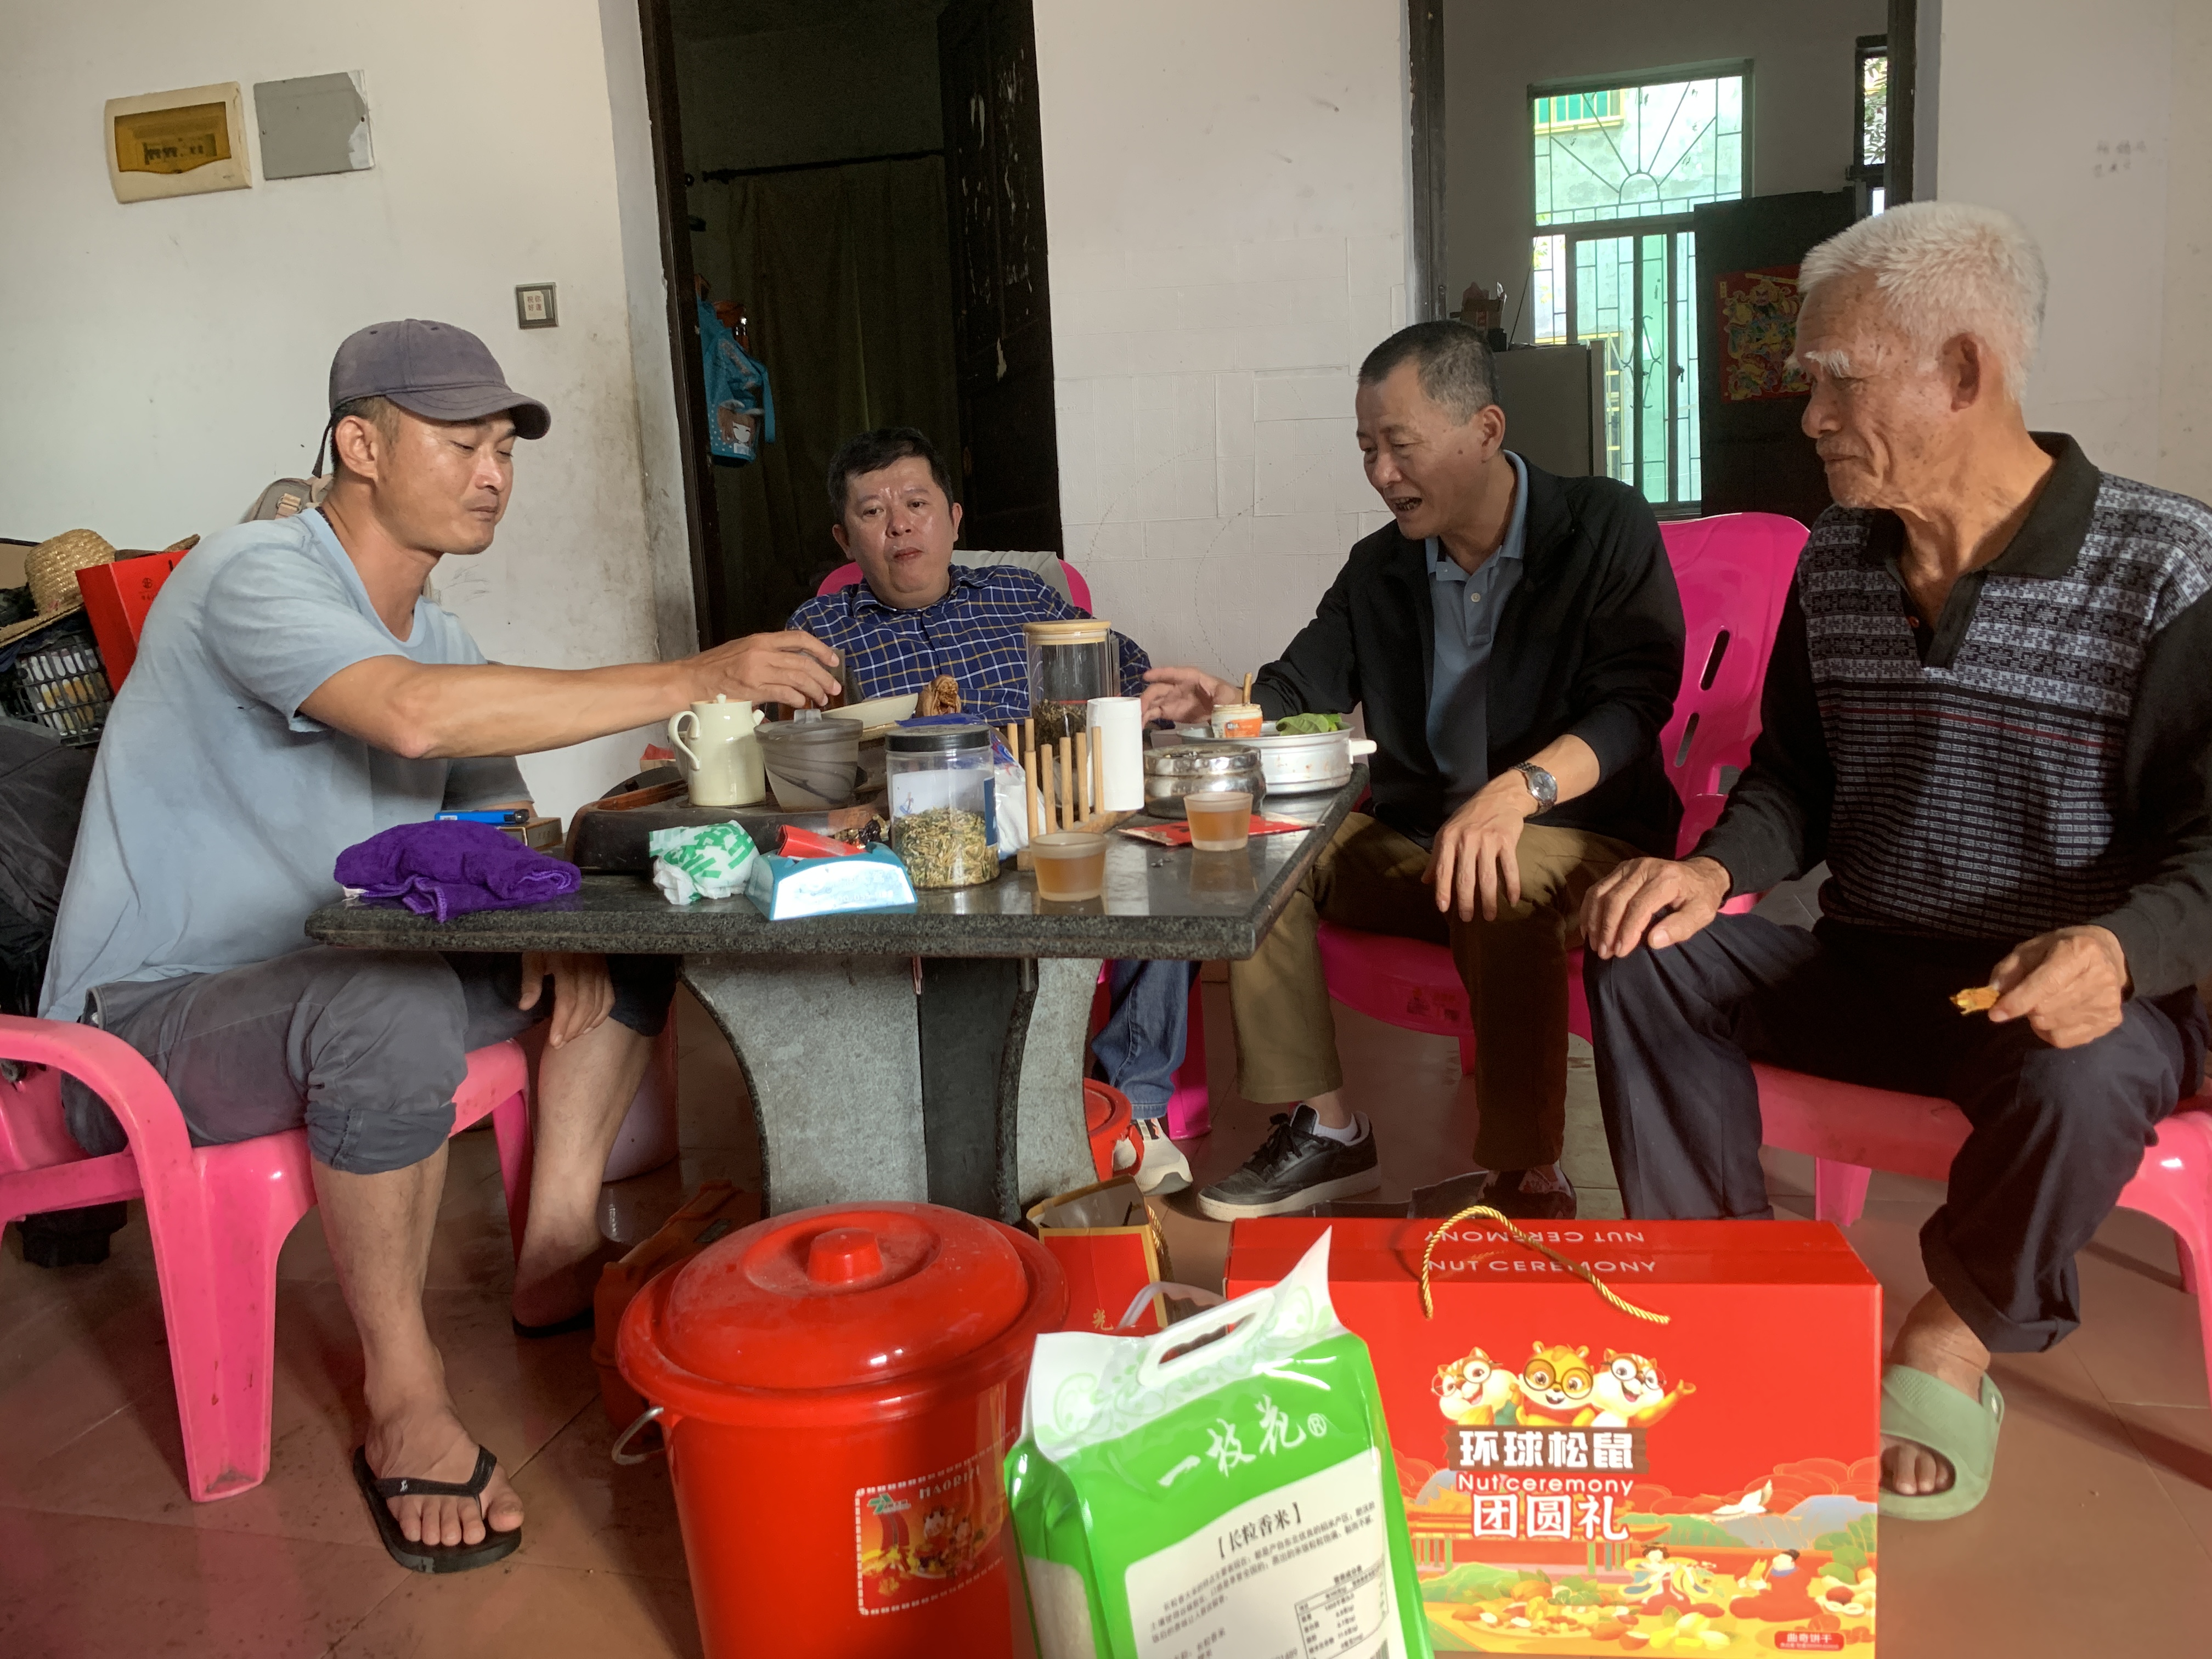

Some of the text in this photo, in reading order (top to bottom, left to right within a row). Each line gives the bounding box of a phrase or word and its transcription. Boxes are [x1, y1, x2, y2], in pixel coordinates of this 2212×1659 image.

[1594, 1232, 1645, 1242] NUT
[1429, 1261, 1480, 1271] NUT
[1459, 1430, 1634, 1469] 环球松鼠
[1458, 1474, 1634, 1497] Nut ceremony
[1473, 1494, 1629, 1541] 团圆礼
[1787, 1632, 1832, 1643] 曲奇饼干
